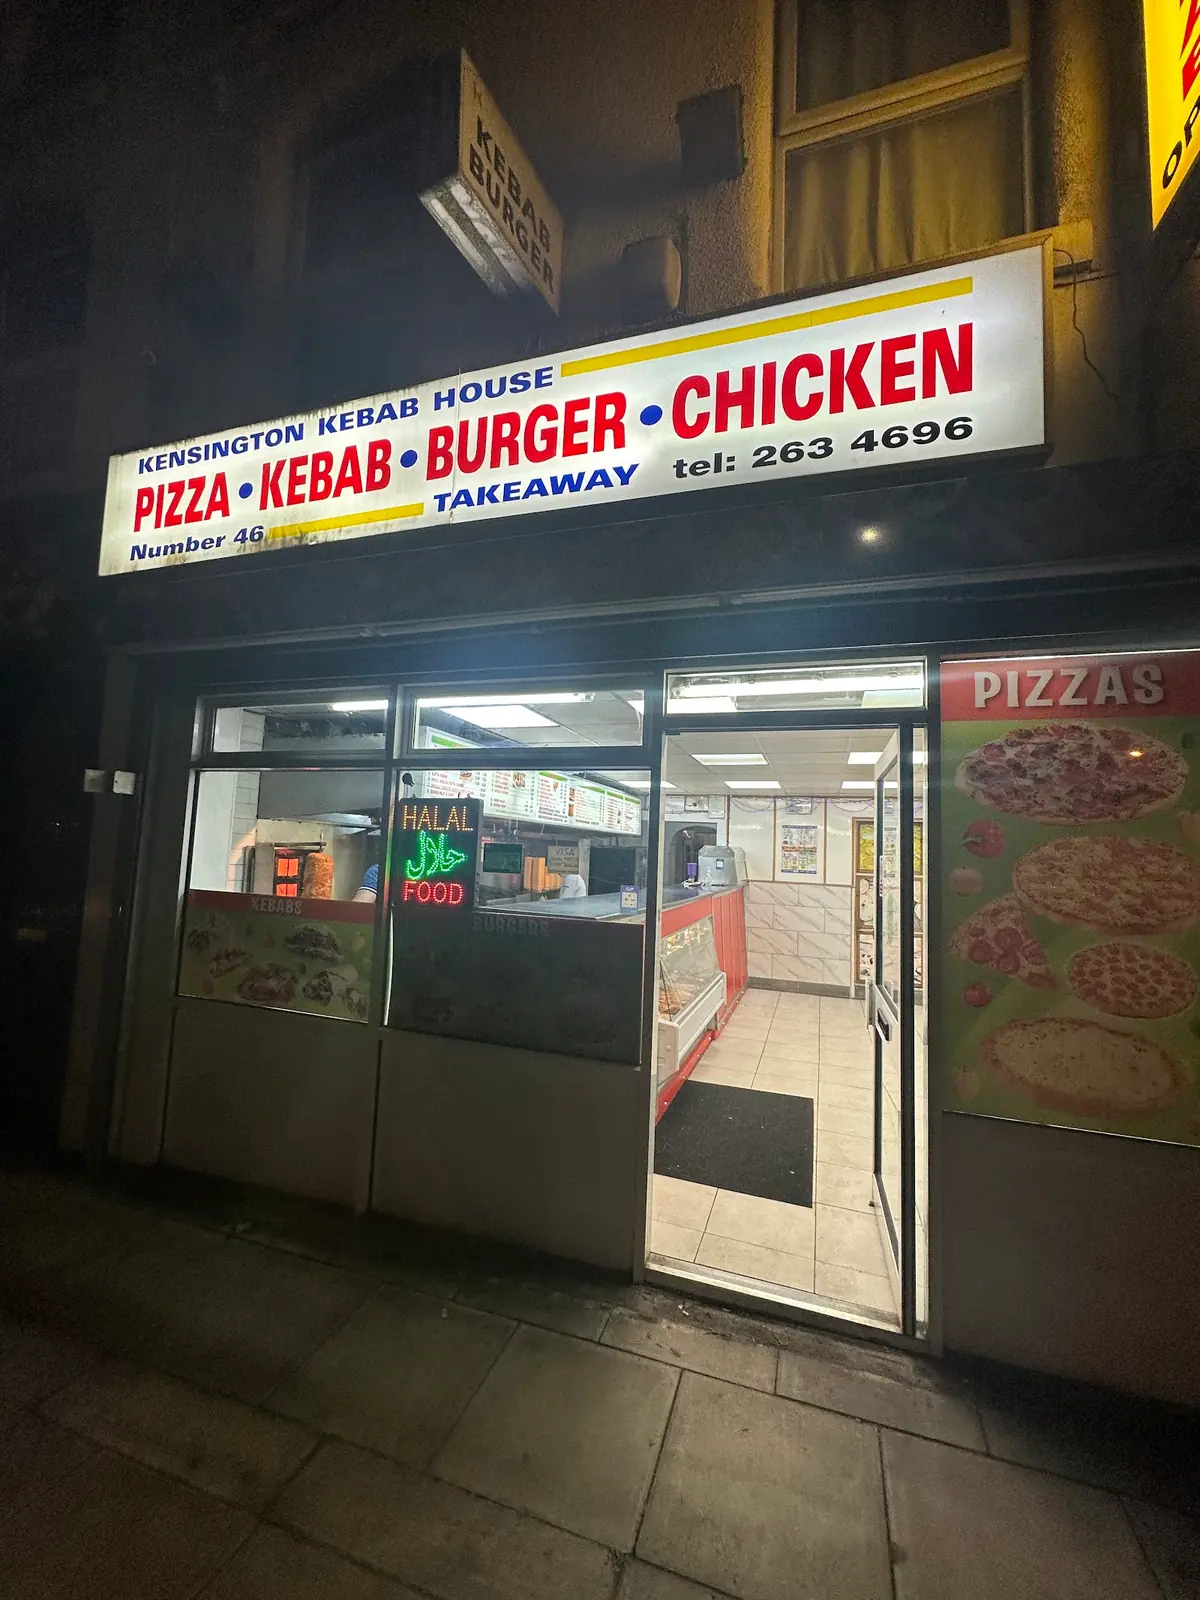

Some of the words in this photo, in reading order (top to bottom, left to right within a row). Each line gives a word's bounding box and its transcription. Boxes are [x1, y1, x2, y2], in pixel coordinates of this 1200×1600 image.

[477, 115, 550, 253] KEBAB
[469, 143, 554, 294] BURGER
[133, 472, 230, 532] PIZZA
[259, 438, 392, 511] KEBAB
[426, 391, 627, 481] BURGER
[672, 322, 973, 440] CHICKEN
[138, 423, 304, 474] KENSINGTON
[318, 398, 419, 436] KEBAB
[434, 366, 553, 411] HOUSE
[673, 452, 736, 479] tel:
[751, 437, 833, 469] 263
[850, 416, 973, 453] 4696
[434, 463, 640, 513] TAKEAWAY
[130, 533, 226, 561] Number
[233, 525, 264, 544] 46
[974, 664, 1164, 709] PIZZAS
[402, 804, 474, 831] HALAL
[555, 847, 575, 857] VISA
[251, 896, 303, 916] KEBABS
[403, 880, 464, 905] FOOD
[472, 915, 550, 938] BURGERS
